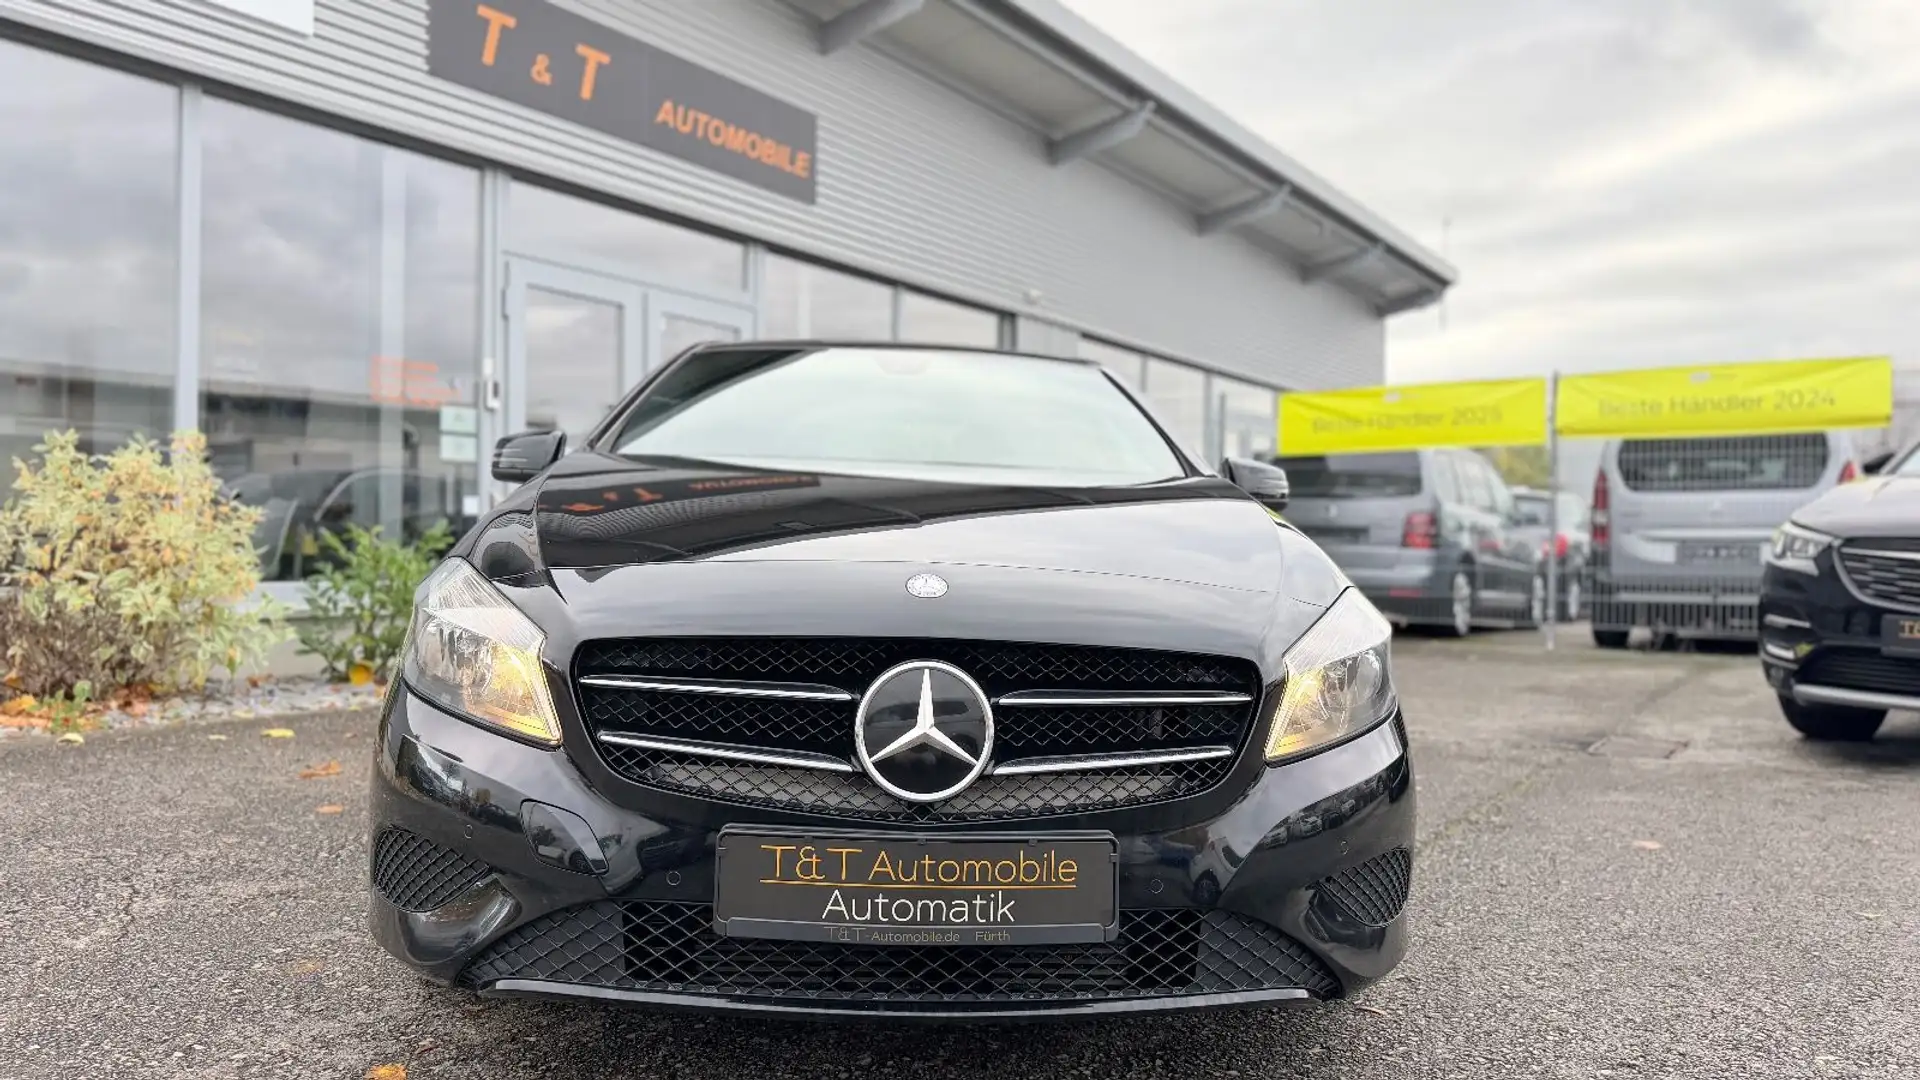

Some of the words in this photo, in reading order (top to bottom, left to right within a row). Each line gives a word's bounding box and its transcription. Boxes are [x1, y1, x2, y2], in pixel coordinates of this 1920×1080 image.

[476, 4, 517, 67] T
[530, 53, 552, 86] &
[575, 43, 611, 100] T
[654, 99, 812, 178] AUTOMOBILE
[1773, 386, 1837, 412] 2024
[760, 844, 863, 881] T&T
[867, 850, 1078, 884] Automobile
[821, 889, 1016, 923] Automatik
[975, 929, 1012, 943] Fürth
